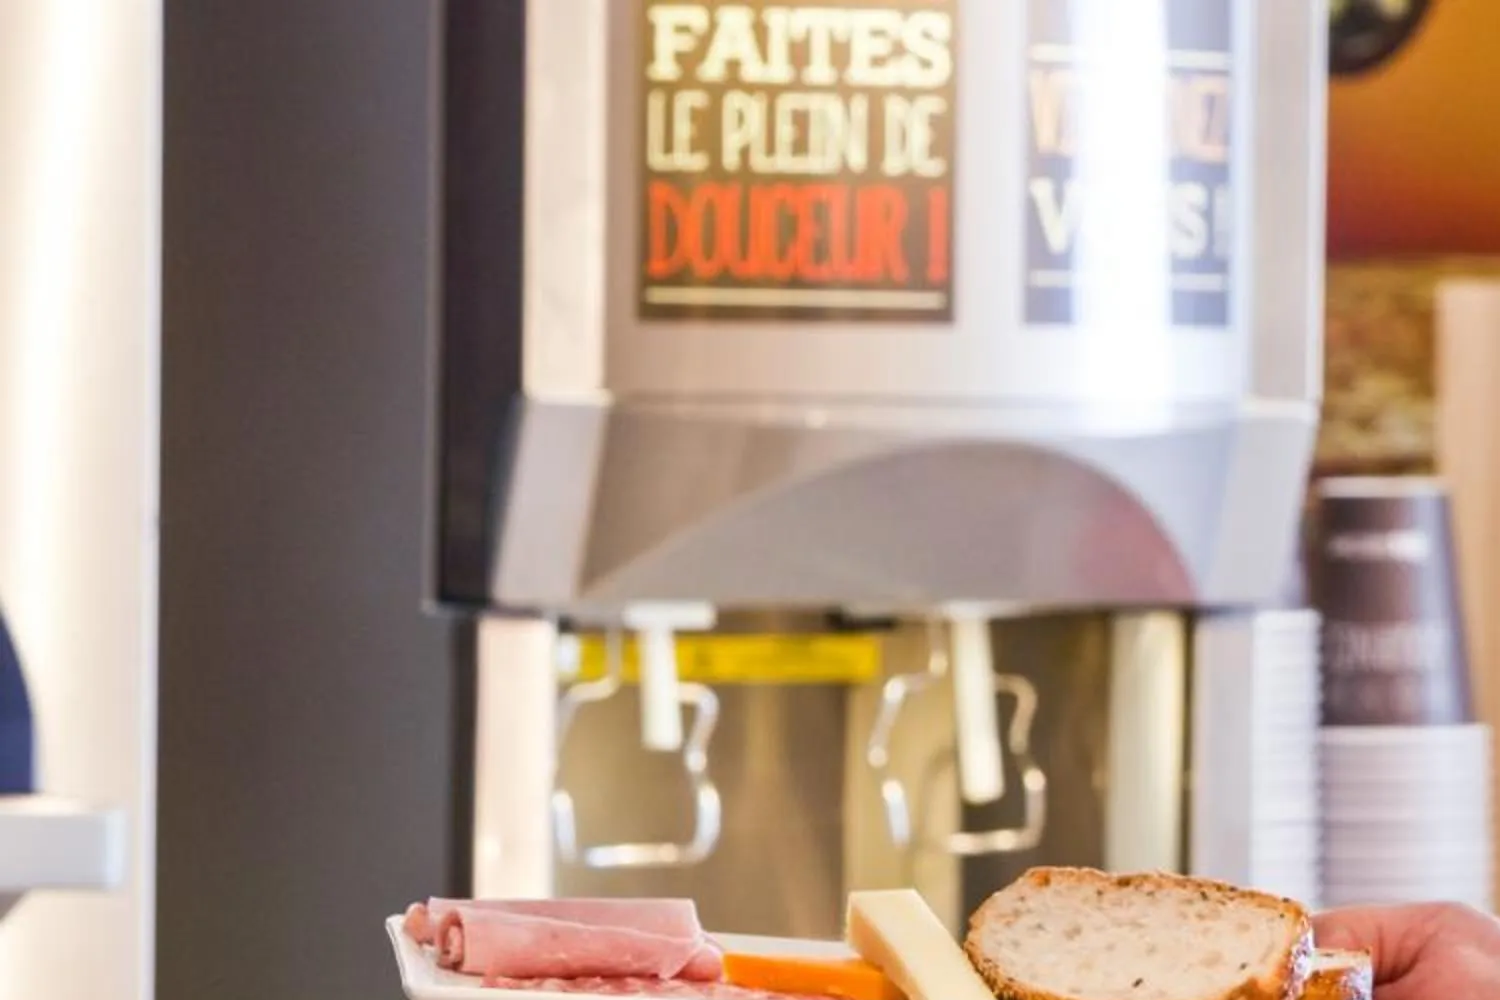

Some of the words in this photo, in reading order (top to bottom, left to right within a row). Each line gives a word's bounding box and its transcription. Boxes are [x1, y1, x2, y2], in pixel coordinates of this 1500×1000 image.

[646, 5, 952, 88] FAITES
[646, 88, 710, 172] LE
[721, 89, 869, 175] PLEIN
[880, 92, 948, 178] DE
[646, 180, 910, 283] DOUCEUR
